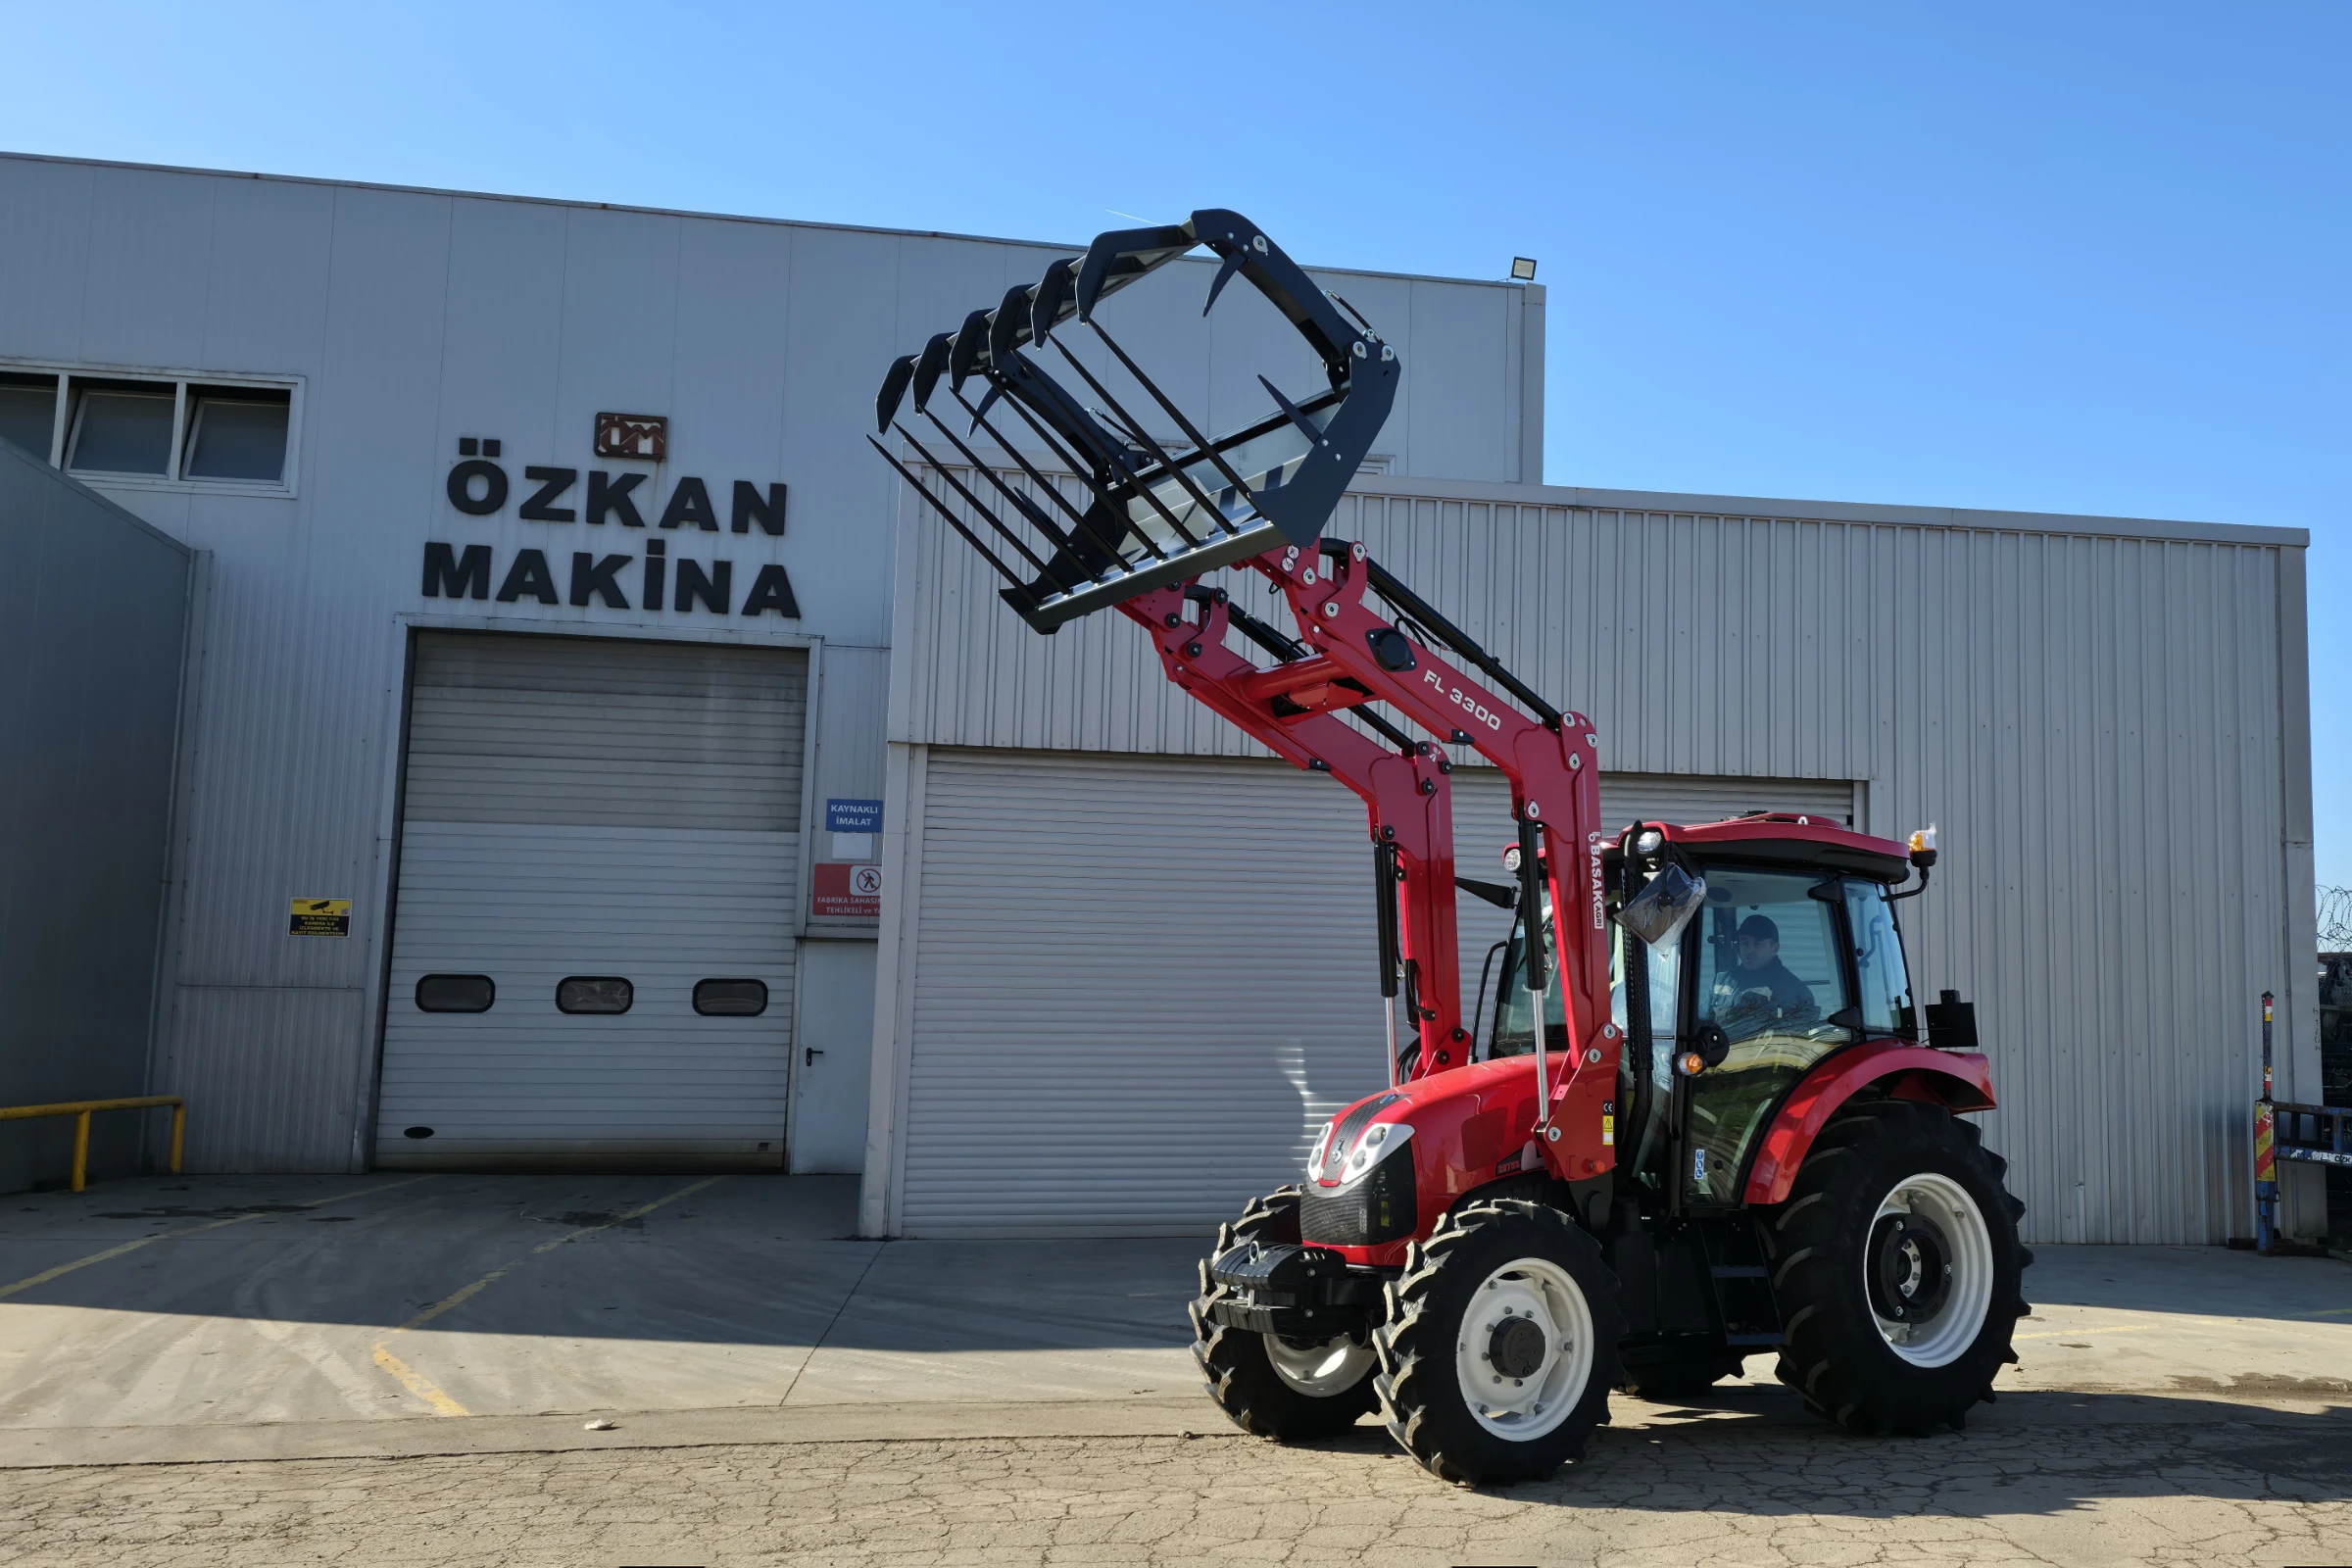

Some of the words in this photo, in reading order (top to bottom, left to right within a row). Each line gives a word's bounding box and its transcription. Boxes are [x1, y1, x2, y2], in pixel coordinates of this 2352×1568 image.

[447, 437, 788, 536] ÖZKAN
[1424, 669, 1446, 694] FL
[1449, 688, 1501, 731] 3300
[830, 805, 878, 814] KAYNAKLI
[836, 815, 872, 826] İMALAT
[1591, 845, 1603, 903] BASAK
[816, 896, 849, 905] FABRİKA
